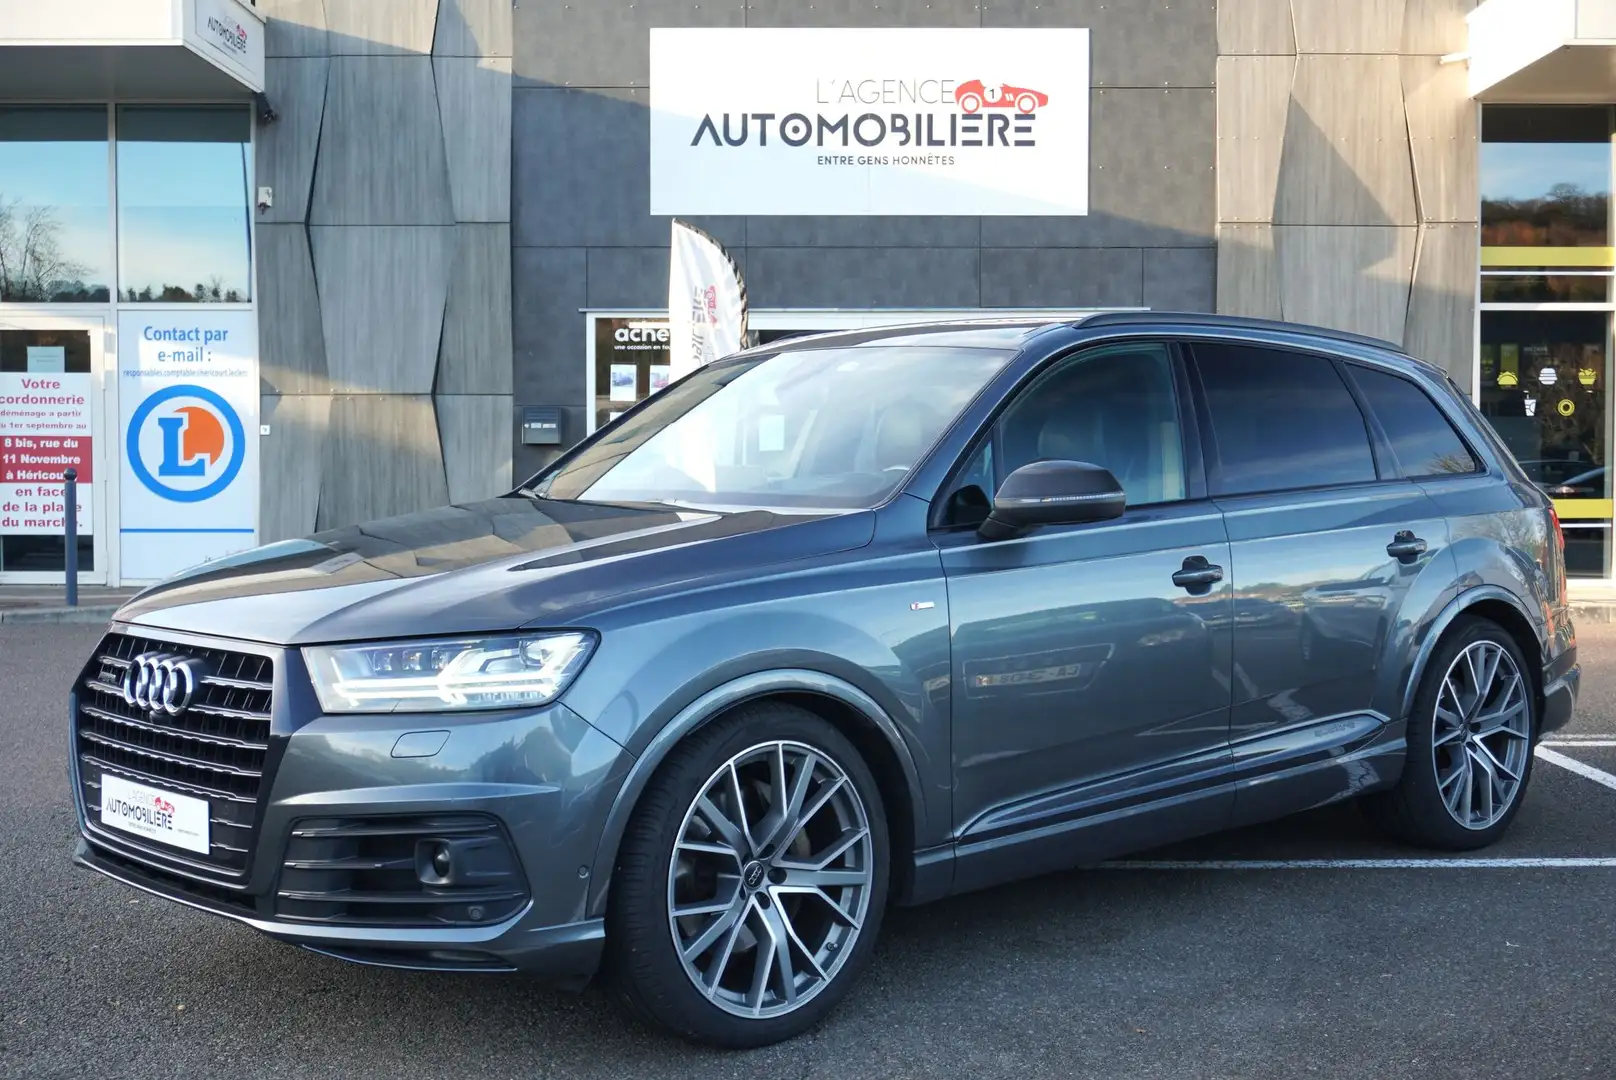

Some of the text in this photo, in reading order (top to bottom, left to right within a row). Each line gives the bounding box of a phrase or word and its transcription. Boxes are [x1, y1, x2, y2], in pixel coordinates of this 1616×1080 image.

[817, 78, 955, 104] L'AGENCE
[817, 153, 955, 165] ENTRE GENS HONNÊTES
[143, 326, 228, 346] Contact par
[614, 327, 670, 342] ache
[158, 346, 204, 362] e-mail
[21, 378, 61, 389] Votre
[0, 393, 85, 405] cordonnerie
[57, 409, 82, 418] partir
[26, 421, 73, 430] septembre
[4, 438, 79, 450] 8 bis, rue du
[3, 454, 81, 464] 11 Novembre
[6, 470, 14, 480] à
[15, 488, 32, 497] en
[2, 502, 82, 514] de la plae
[2, 517, 19, 527] du
